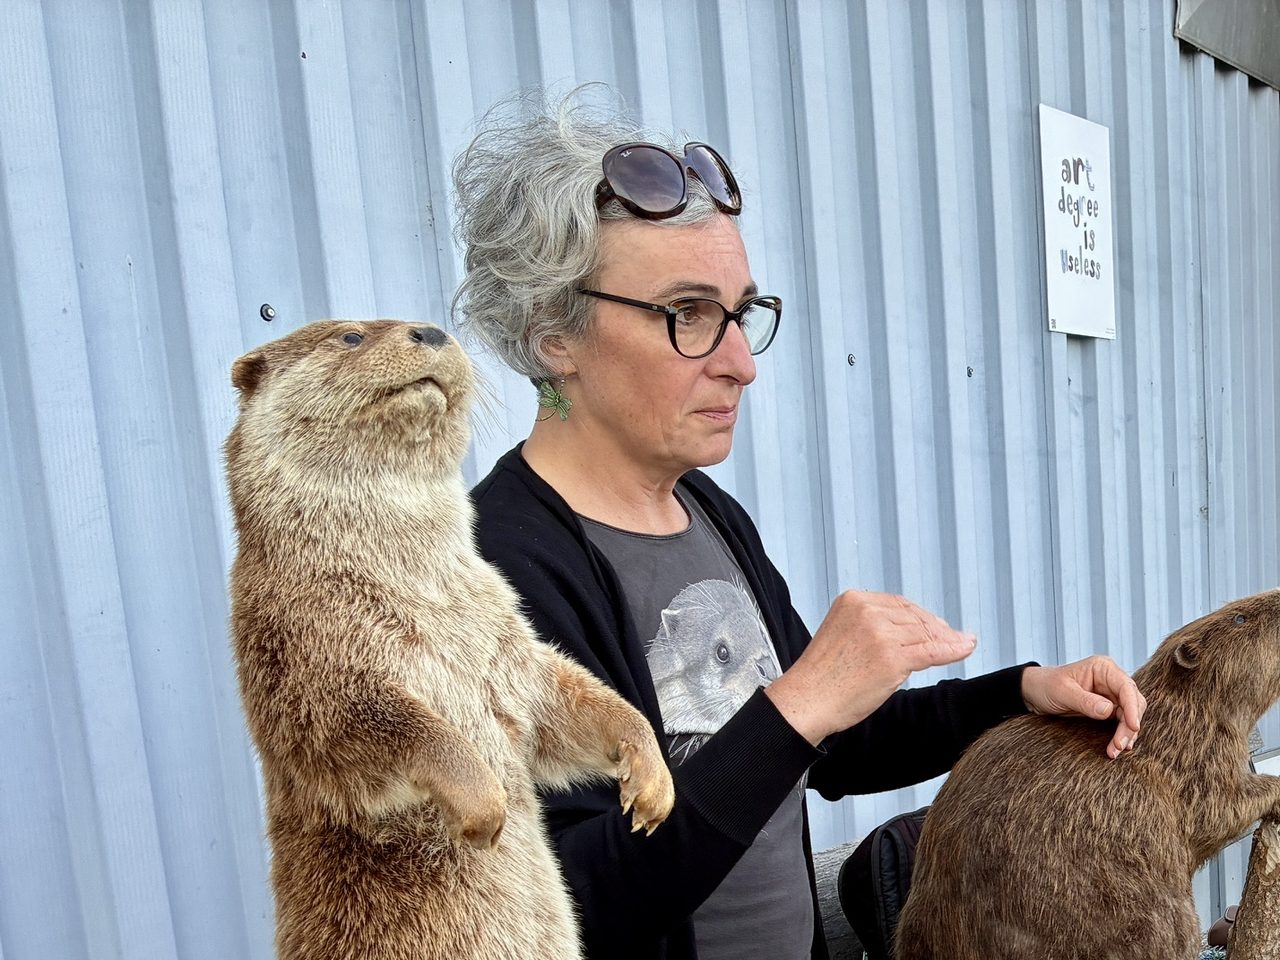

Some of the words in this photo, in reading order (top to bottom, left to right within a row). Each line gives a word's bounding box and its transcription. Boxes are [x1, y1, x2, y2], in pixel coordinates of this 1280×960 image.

[1061, 157, 1095, 191] art
[1058, 186, 1099, 228] degree
[1083, 222, 1096, 251] is
